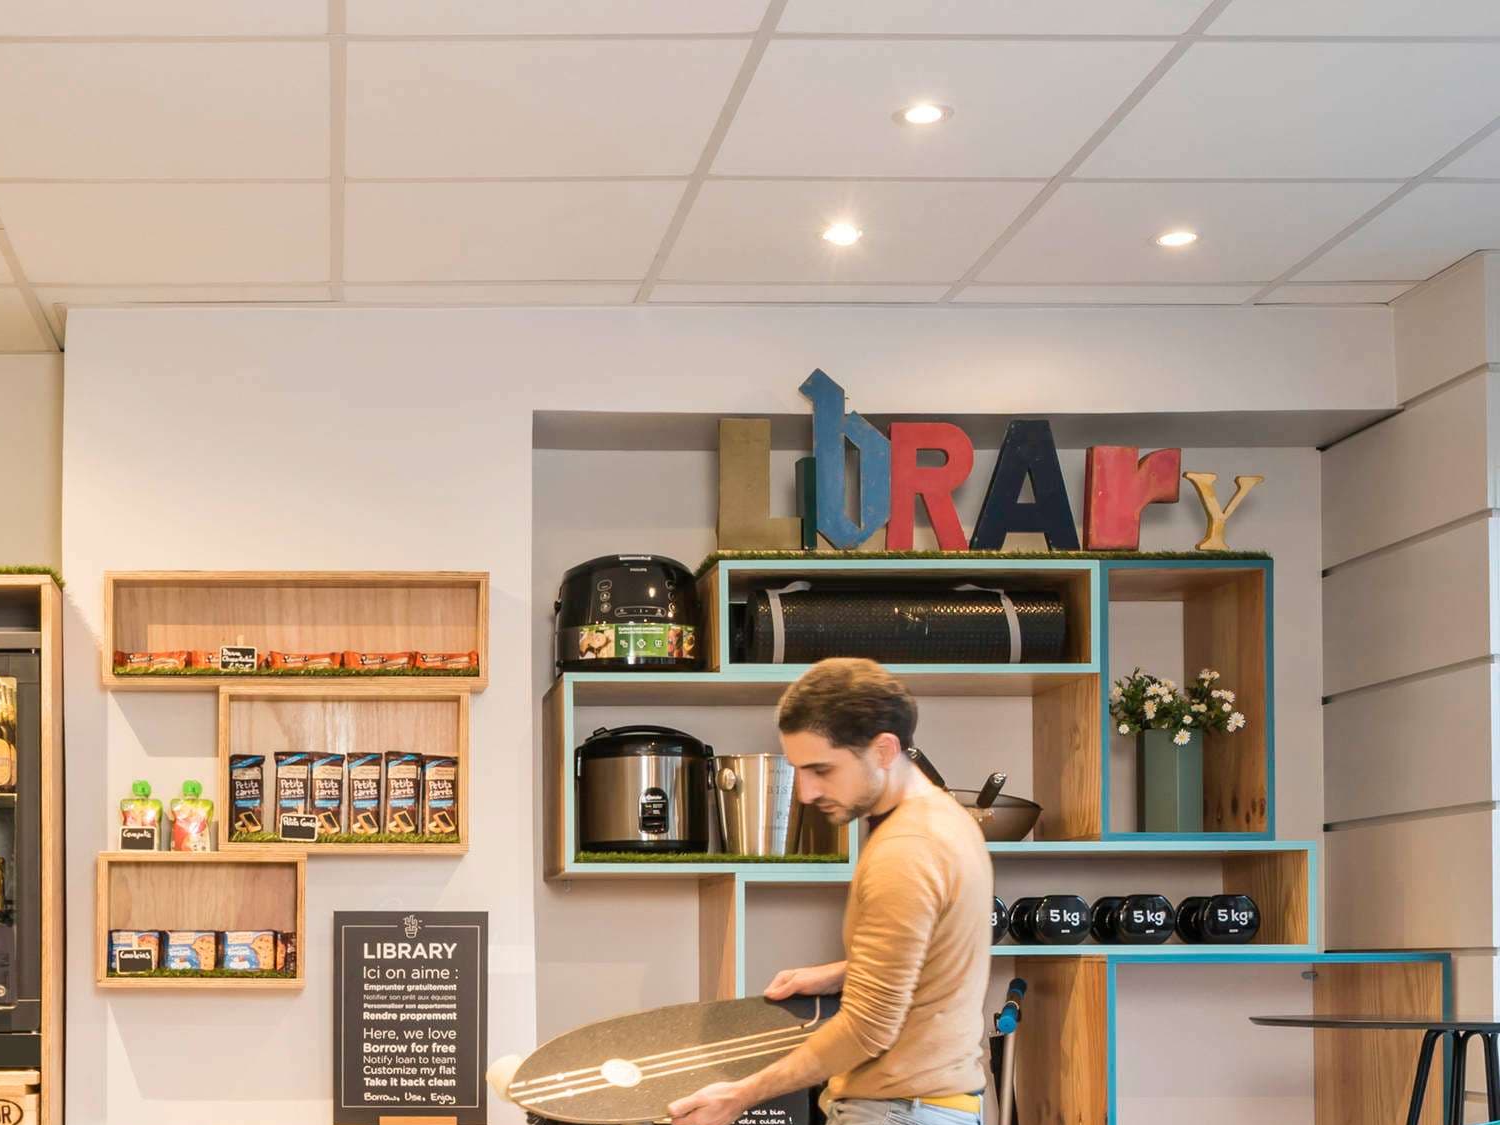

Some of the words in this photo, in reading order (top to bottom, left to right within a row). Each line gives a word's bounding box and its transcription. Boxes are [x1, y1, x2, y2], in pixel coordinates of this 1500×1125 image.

[1050, 909, 1061, 922] 5
[1063, 909, 1081, 925] kg
[1133, 910, 1144, 923] 5
[1146, 909, 1164, 925] kg
[1217, 909, 1228, 922] 5
[1231, 909, 1249, 925] kg
[119, 950, 151, 959] Cookies
[363, 942, 457, 959] LIBRARY
[363, 965, 380, 979] Ici
[385, 968, 406, 979] on
[411, 965, 450, 979] aime
[363, 983, 405, 992] Emprunter
[406, 983, 457, 992] gratuitement
[363, 1012, 398, 1020] Rendre
[400, 1012, 457, 1022] proprement
[363, 1027, 399, 1041] Here,
[403, 1030, 424, 1039] we
[428, 1027, 457, 1039] love
[363, 1042, 408, 1053] Borrow
[411, 1042, 429, 1053] for
[431, 1042, 456, 1053] free
[363, 1055, 393, 1065] Notify
[395, 1055, 416, 1064] loan
[419, 1056, 429, 1064] to
[432, 1056, 456, 1064] team
[363, 1066, 417, 1075] Customize
[420, 1067, 436, 1076] my
[439, 1065, 456, 1075] flat
[363, 1077, 387, 1087] Take
[390, 1077, 398, 1087] it
[400, 1077, 425, 1087] back
[428, 1077, 456, 1087] clean
[430, 1092, 456, 1105] Enjoy
[770, 1108, 786, 1116] bien
